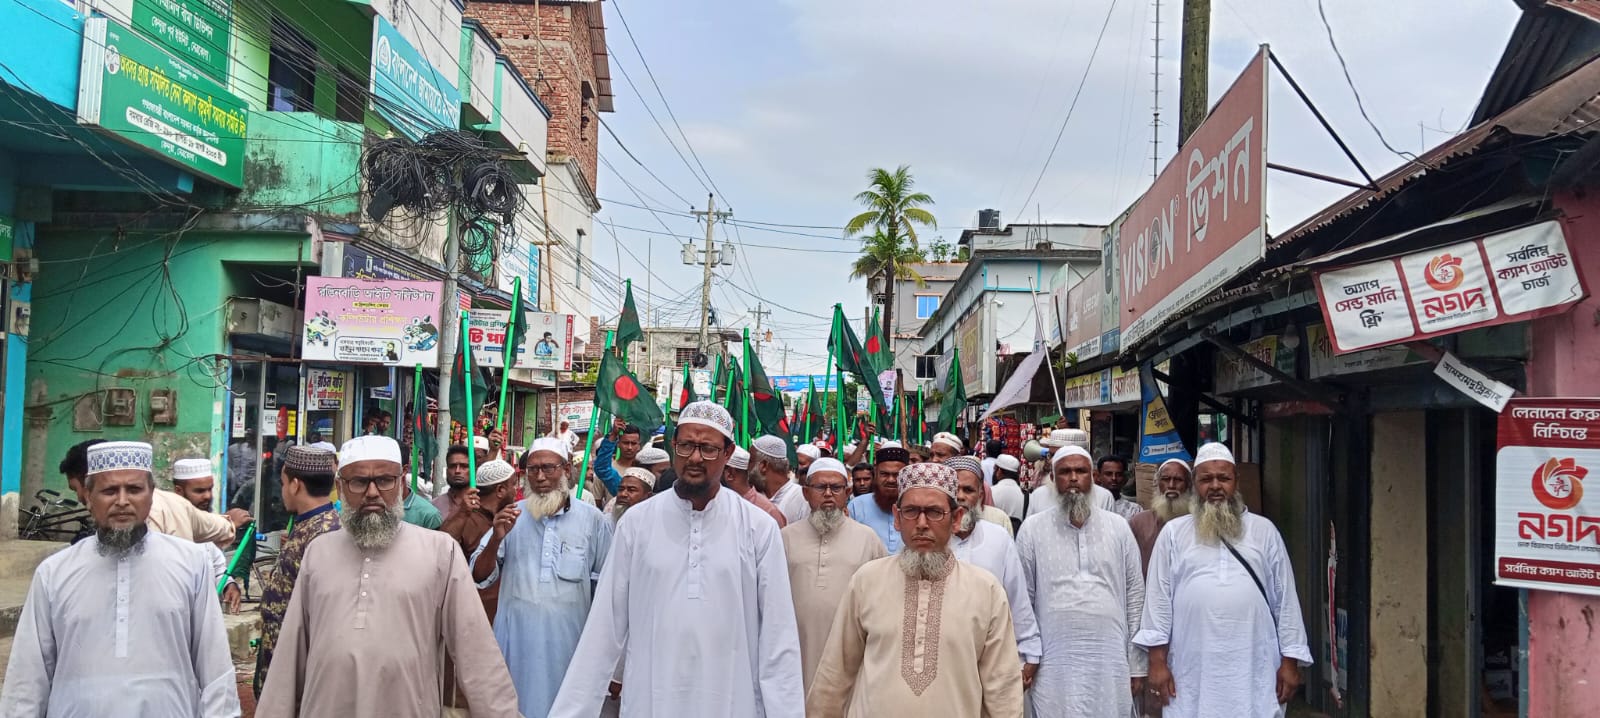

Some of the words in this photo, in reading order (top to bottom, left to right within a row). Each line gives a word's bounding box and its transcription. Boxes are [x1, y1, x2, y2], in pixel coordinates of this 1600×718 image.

[1185, 115, 1254, 253] ভিশন
[1506, 244, 1550, 262] সর্বনিম্ন
[1496, 264, 1530, 280] ক্যাশ
[1529, 253, 1568, 273] আউট
[1343, 279, 1380, 295] অ্যাপে
[1521, 272, 1551, 290] চার্জ
[1335, 296, 1364, 312] সেন্ড
[1364, 286, 1397, 306] মানি
[1421, 287, 1487, 318] নগদ
[1511, 407, 1567, 420] লেনদেন
[1568, 407, 1600, 422] করু
[1532, 422, 1588, 440] নিশ্চিন্তে
[1517, 511, 1600, 546] নগদ
[1505, 562, 1538, 575] সর্বনিম্ন
[1539, 566, 1564, 577] ক্যাশ
[1565, 567, 1595, 579] আউট
